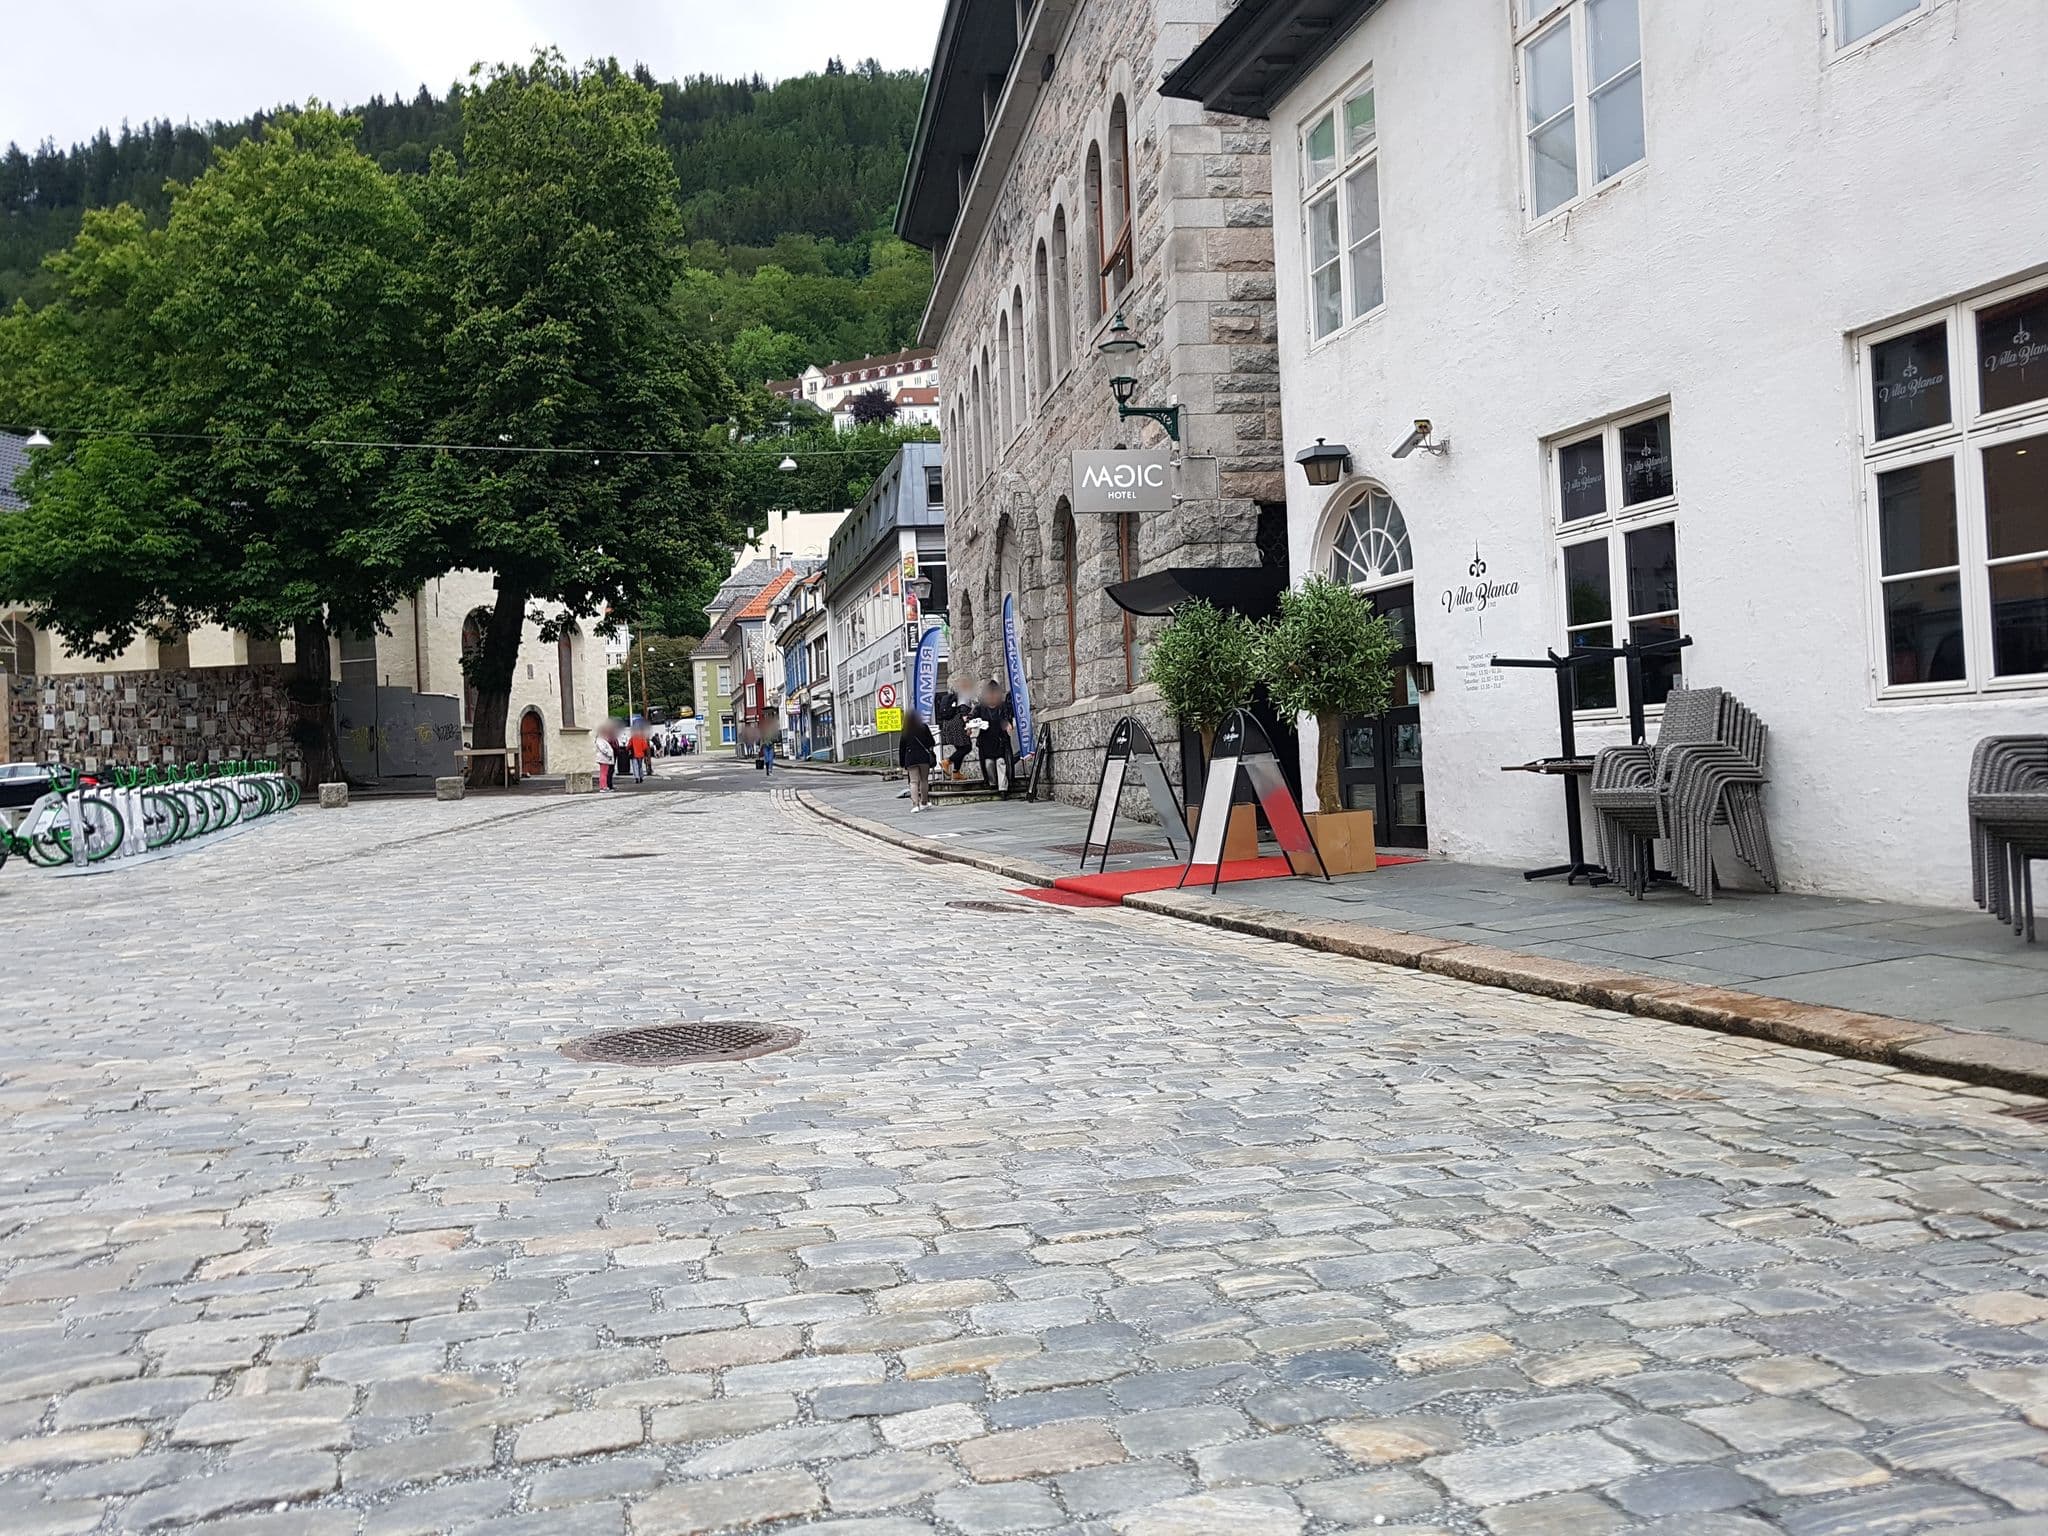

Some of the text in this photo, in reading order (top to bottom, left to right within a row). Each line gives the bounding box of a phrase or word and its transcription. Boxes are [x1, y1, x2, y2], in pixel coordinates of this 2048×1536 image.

[1984, 342, 2048, 372] Villa Blan
[1878, 374, 1943, 402] Villa Blanca
[1081, 463, 1164, 488] MAGIC
[1107, 491, 1137, 499] HOTEL
[1441, 580, 1519, 613] Villa Blanca
